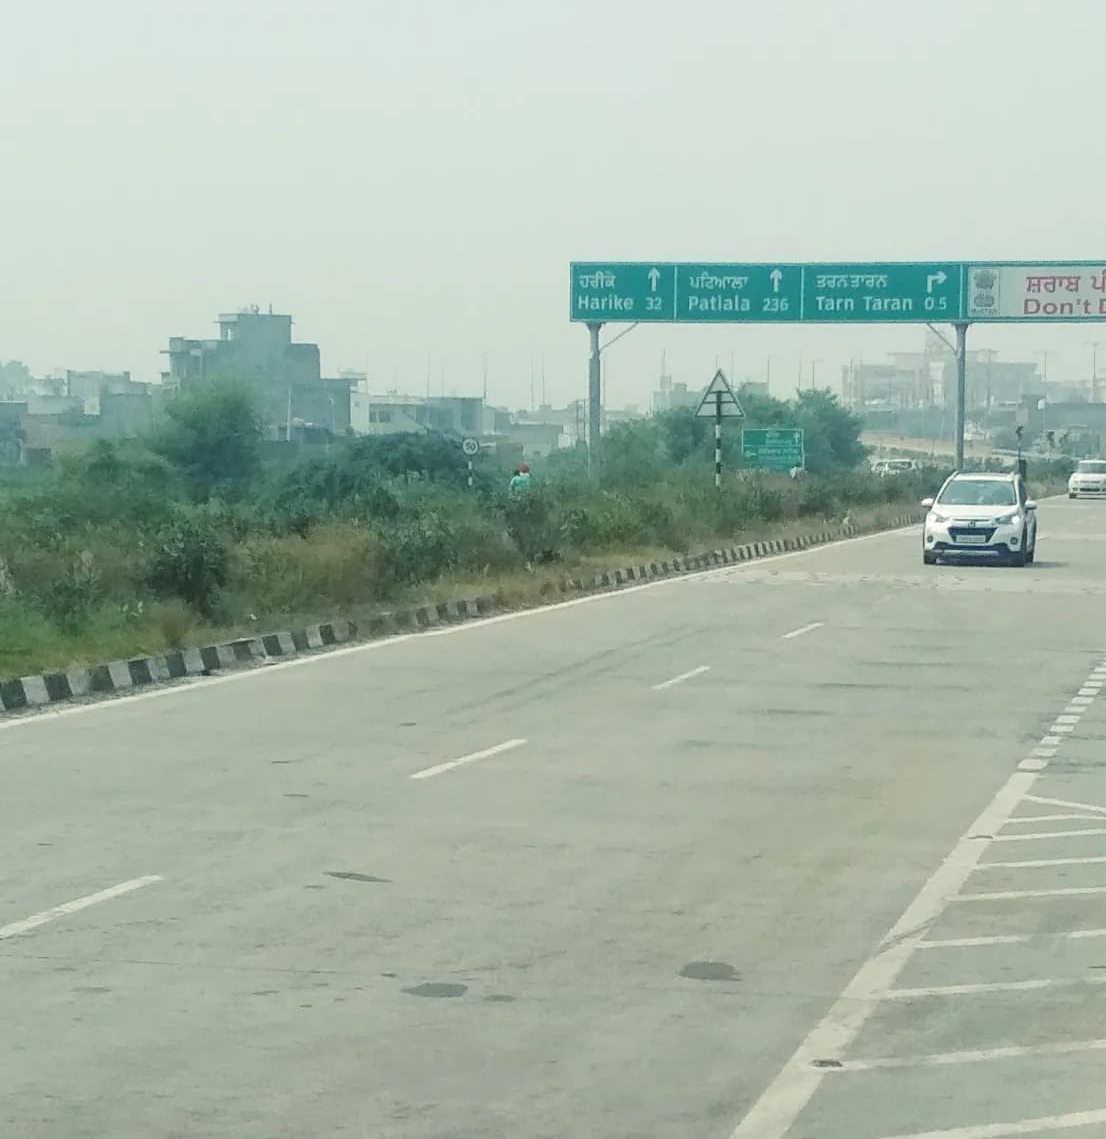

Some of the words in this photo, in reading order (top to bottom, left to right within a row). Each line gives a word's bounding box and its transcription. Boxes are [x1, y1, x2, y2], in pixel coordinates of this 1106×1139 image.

[578, 294, 634, 310] Harike
[645, 297, 662, 310] 32
[688, 295, 750, 311] Patiala
[762, 298, 789, 311] 236
[816, 296, 854, 311] Tarn
[863, 296, 912, 311] Taran
[1023, 298, 1091, 315] Don't
